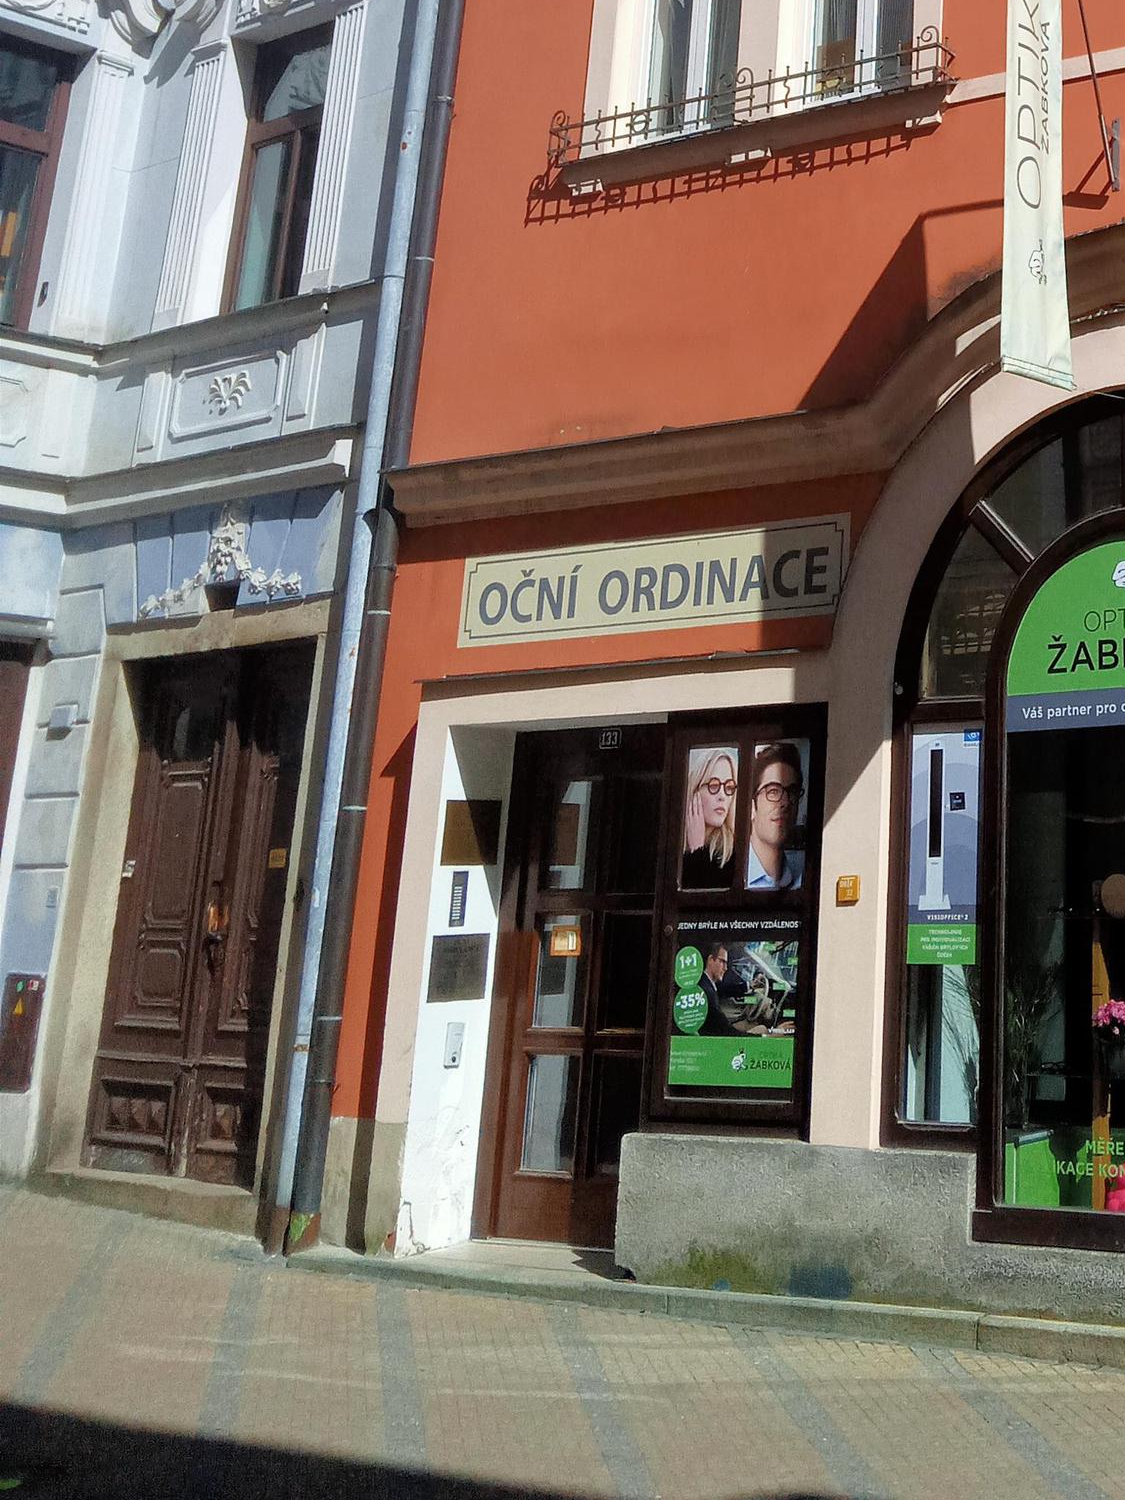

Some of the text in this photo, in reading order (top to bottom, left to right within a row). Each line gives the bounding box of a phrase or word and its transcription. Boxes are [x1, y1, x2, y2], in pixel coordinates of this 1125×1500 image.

[478, 546, 830, 626] OČNÍ ORDINACE
[1022, 706, 1043, 719] Váš
[1047, 703, 1092, 720] partner
[1096, 703, 1117, 716] pro
[677, 921, 698, 930] JEDNY
[698, 920, 718, 930] BRÝLE
[719, 921, 728, 929] NA
[729, 919, 759, 929] VŠECHNY
[679, 953, 697, 969] 1+1
[675, 991, 706, 1009] -35%
